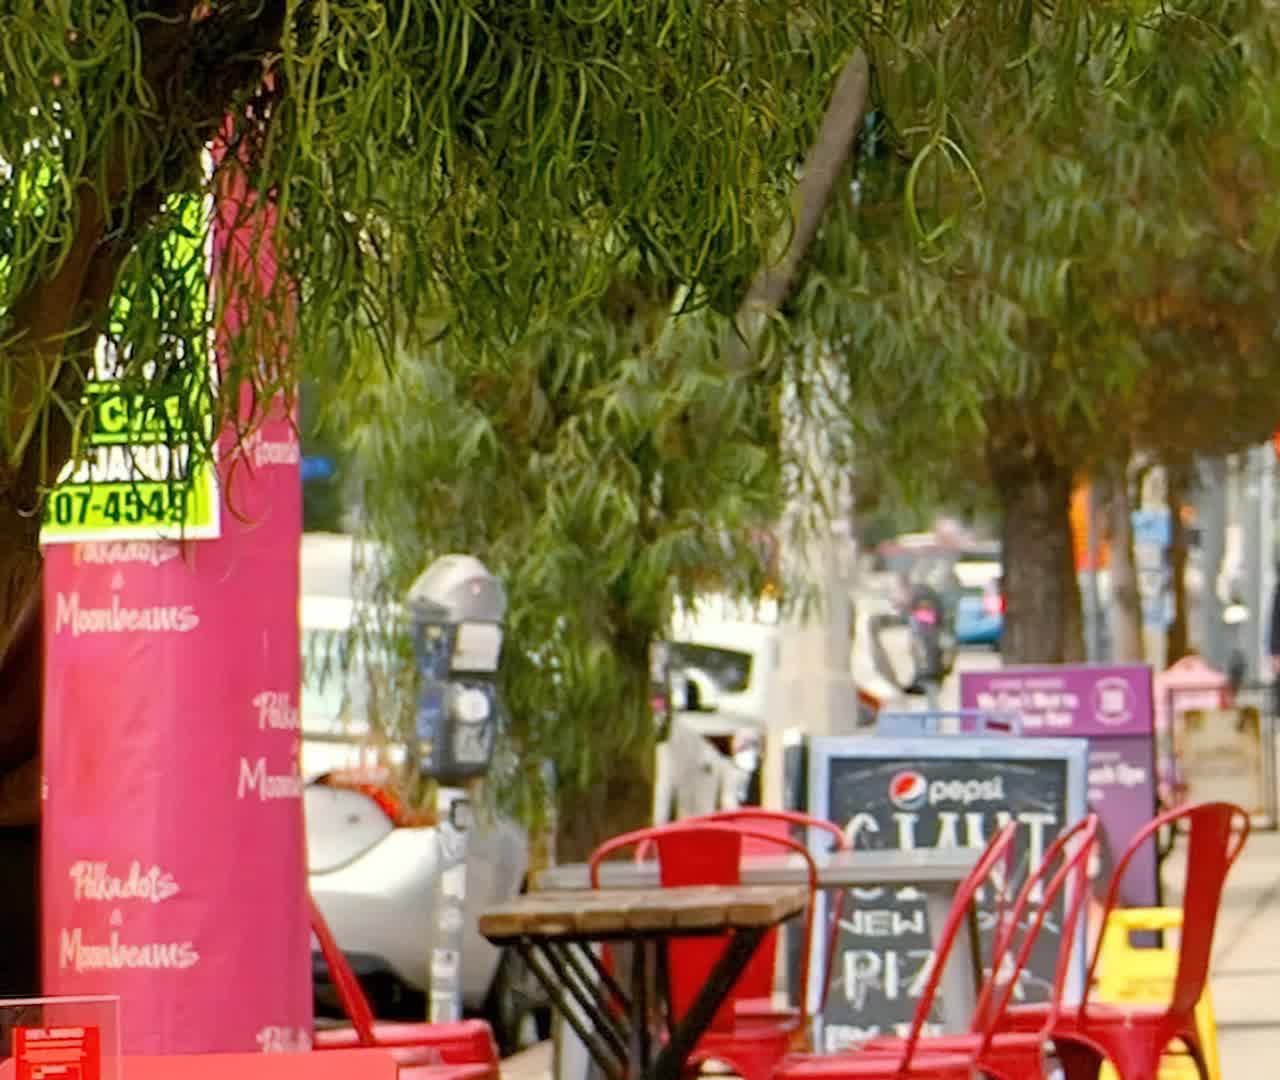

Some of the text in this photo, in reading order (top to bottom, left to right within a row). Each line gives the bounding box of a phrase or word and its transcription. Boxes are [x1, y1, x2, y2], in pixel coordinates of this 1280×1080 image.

[55, 593, 200, 635] Moonbeams
[929, 775, 1005, 804] pepsi
[69, 860, 181, 903] Polkadots
[60, 928, 200, 973] Moonbeams
